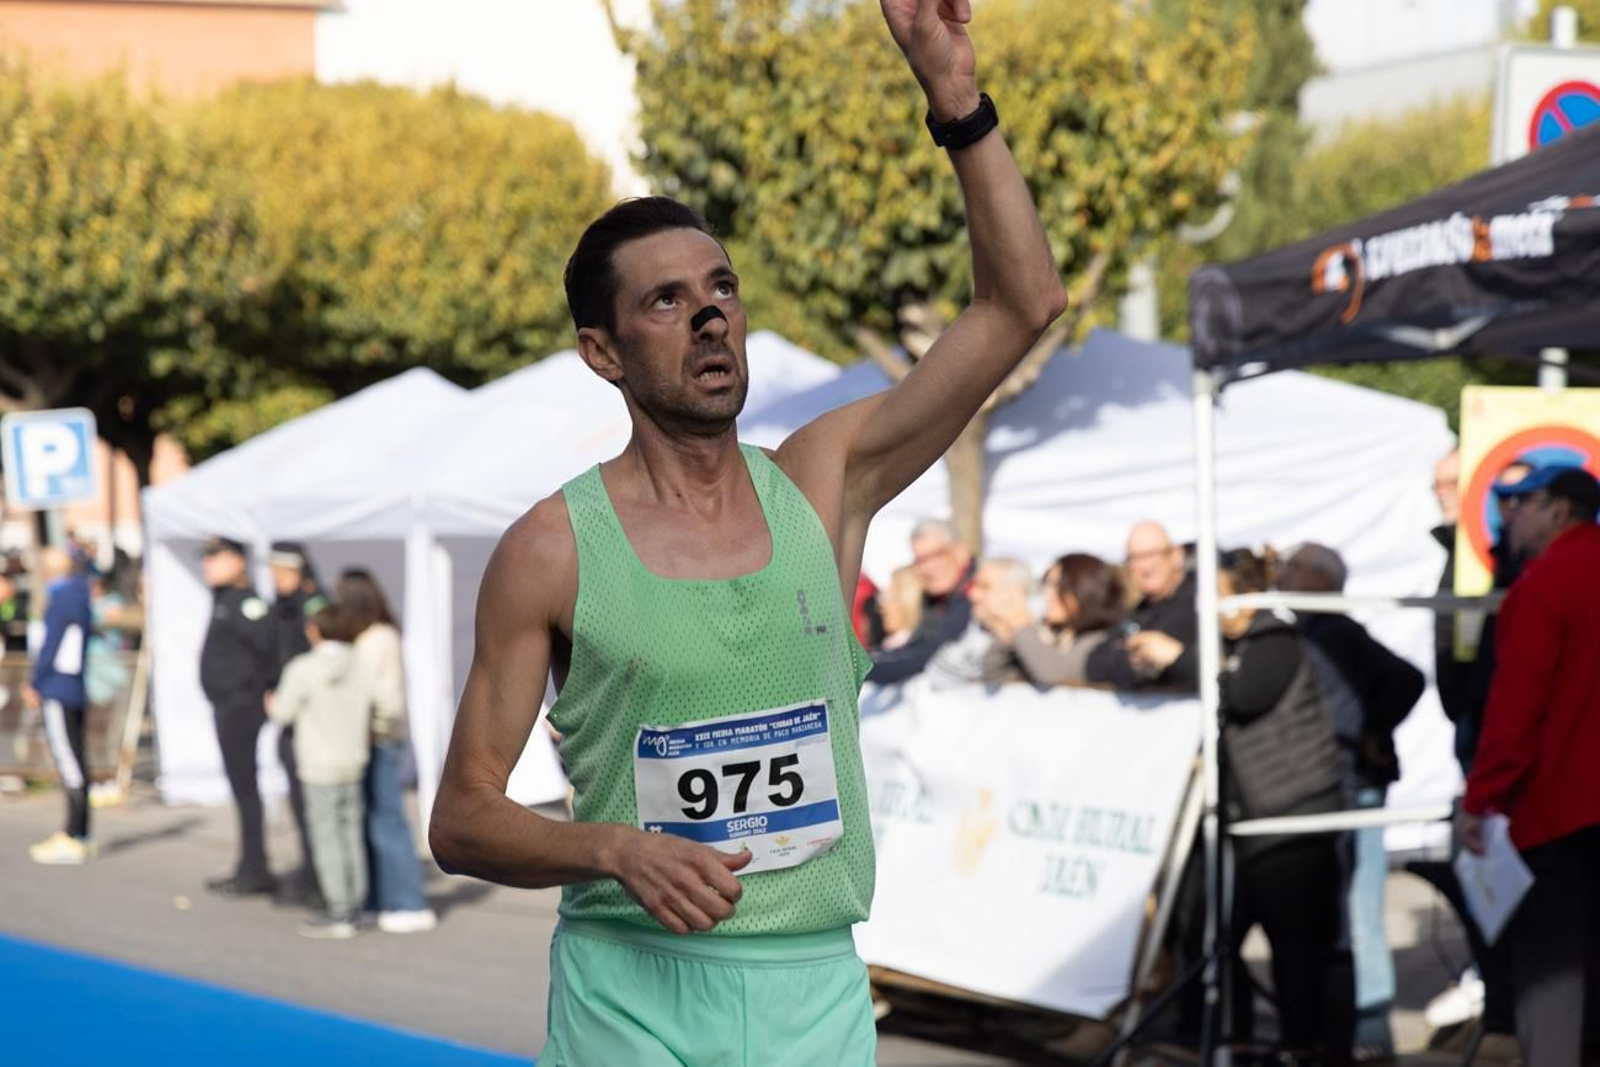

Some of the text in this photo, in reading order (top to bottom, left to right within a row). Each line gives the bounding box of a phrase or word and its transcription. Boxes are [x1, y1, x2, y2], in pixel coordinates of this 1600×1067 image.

[21, 423, 80, 499] P
[730, 733, 760, 744] MEMORIA
[762, 731, 771, 740] DE
[774, 728, 789, 738] PACO
[734, 722, 768, 735] MARATÓN
[677, 753, 804, 820] 975
[726, 815, 768, 833] SERGIO
